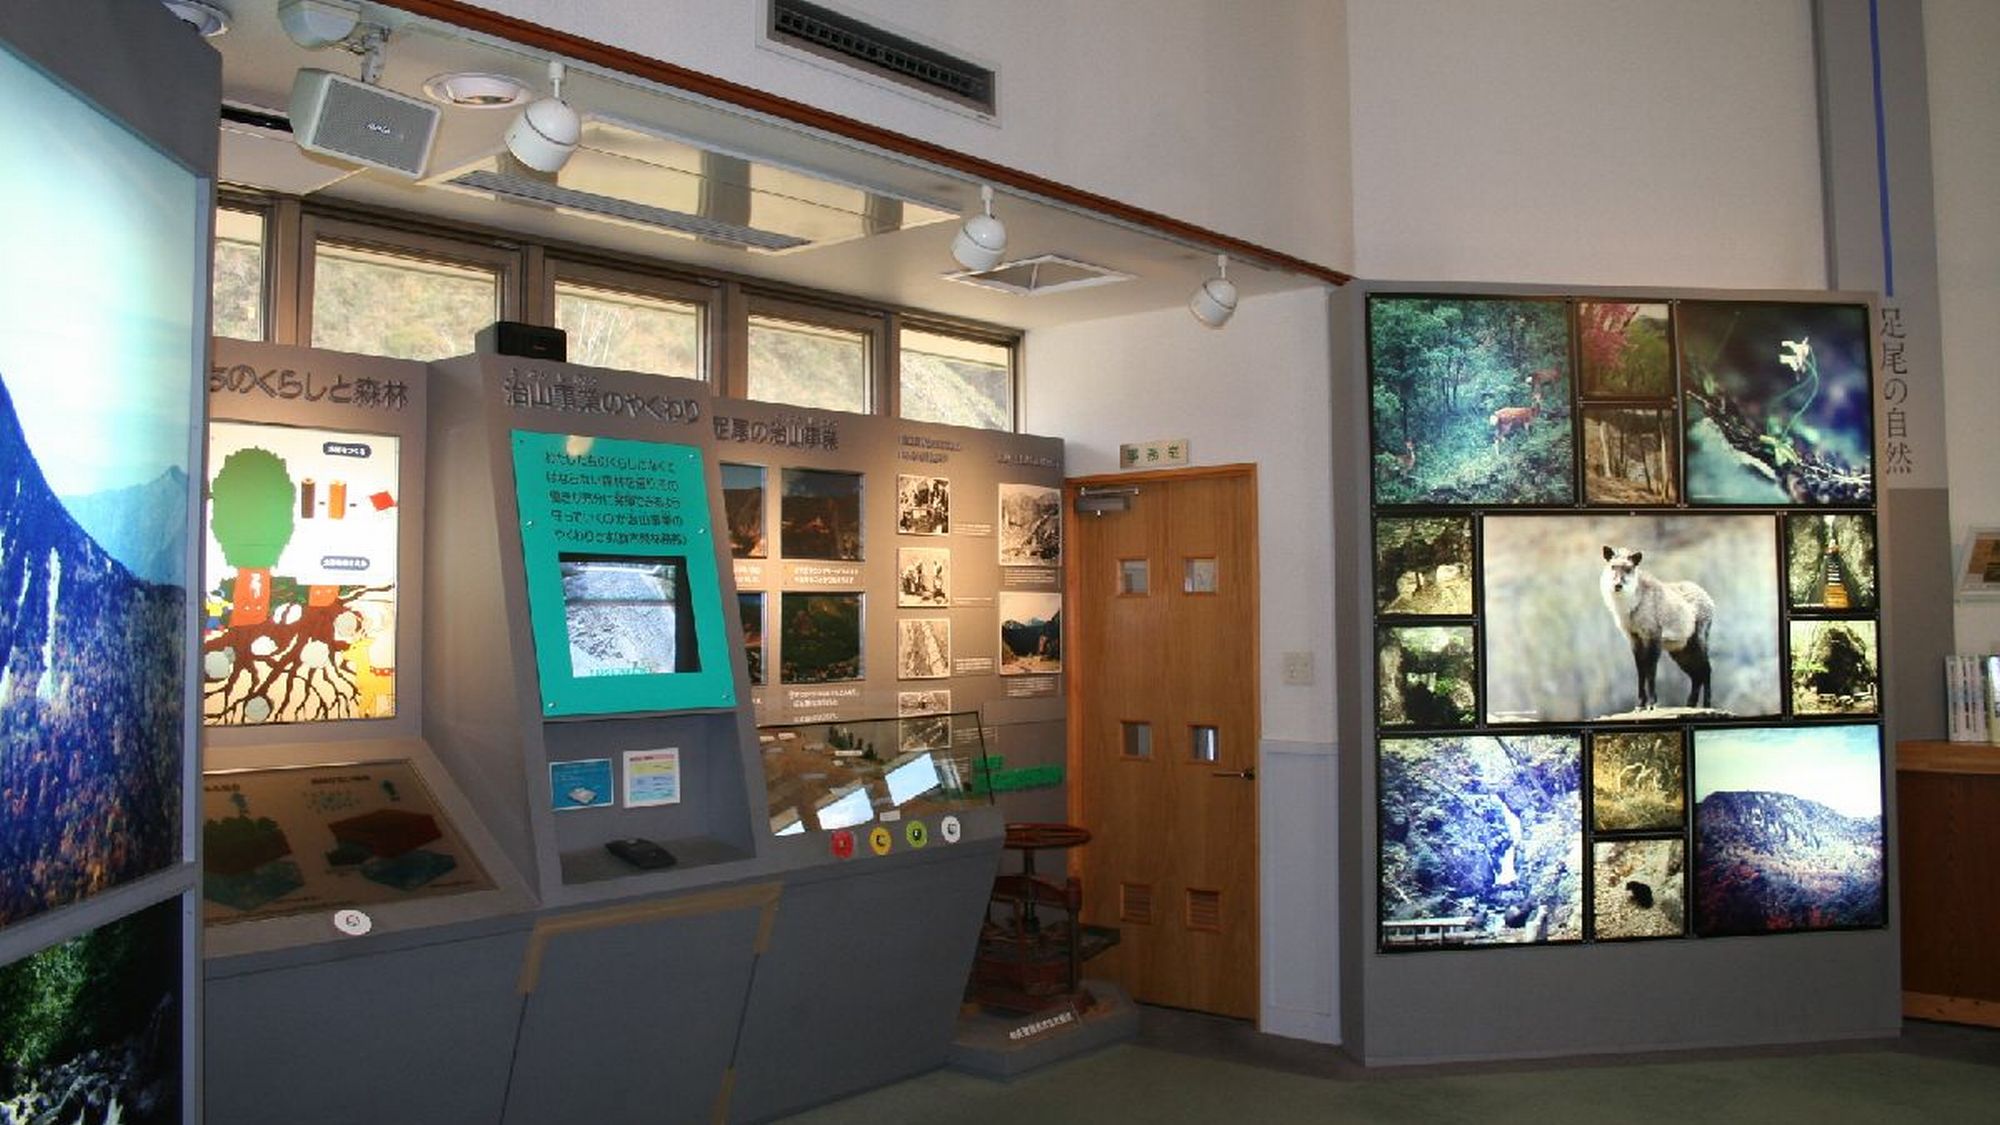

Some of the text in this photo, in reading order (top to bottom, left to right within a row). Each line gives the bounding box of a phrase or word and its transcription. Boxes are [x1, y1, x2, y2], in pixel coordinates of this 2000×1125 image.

[503, 376, 700, 425] 治山事業のやくわり
[1880, 308, 1912, 475] 足尾の自然
